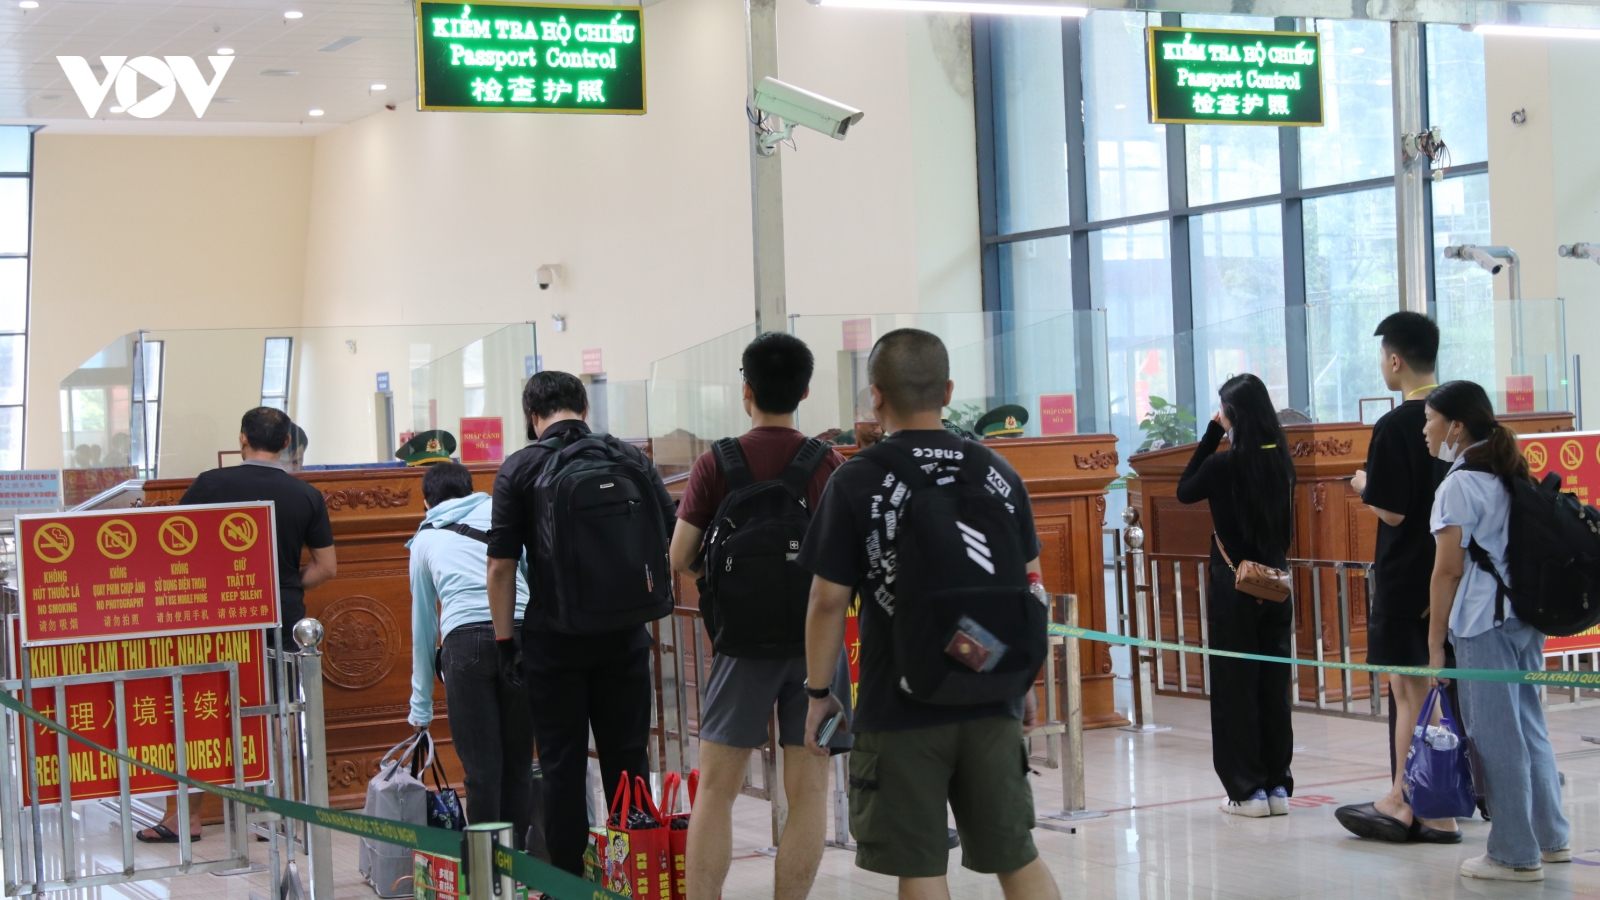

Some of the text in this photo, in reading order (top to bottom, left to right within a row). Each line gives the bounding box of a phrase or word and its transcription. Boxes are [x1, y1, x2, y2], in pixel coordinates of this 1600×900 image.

[433, 5, 635, 46] KIỂM TRA HỘ CHIẾU
[1163, 33, 1315, 67] KIỂM TRA HỘ CHIẾU
[450, 44, 617, 71] Passport Control
[1177, 68, 1301, 92] Passport Control
[471, 76, 605, 103] 检查护照
[1192, 92, 1290, 115] 检查护照
[463, 431, 501, 441] NHẬP CẢNH
[475, 440, 485, 449] SỐ
[171, 561, 189, 575] KHÔNG
[234, 557, 247, 571] GIỮ
[44, 569, 67, 583] KHÔNG
[110, 565, 127, 579] KHÔNG
[93, 578, 145, 598] QUAY PHIM CHỤP ẢNH
[155, 576, 206, 594] SỬ DỤNG ĐIỆN THOẠI
[227, 573, 256, 589] TRẬT TỰ
[33, 582, 80, 600] HÚT THUỐC LÁ
[221, 590, 262, 602] KEEP SILENT
[96, 597, 144, 610] NO PHOTOGRAPHY
[155, 593, 208, 606] DON'T USE MOBILE PHONE
[38, 602, 77, 615] NO SMOKING
[218, 605, 269, 619] 请保持安静
[104, 614, 139, 627] 请勿拍照
[157, 609, 209, 623] 请勿使用手机
[39, 618, 79, 632] 请勿吸烟
[30, 645, 57, 679] KHU
[225, 735, 257, 767] AEA
